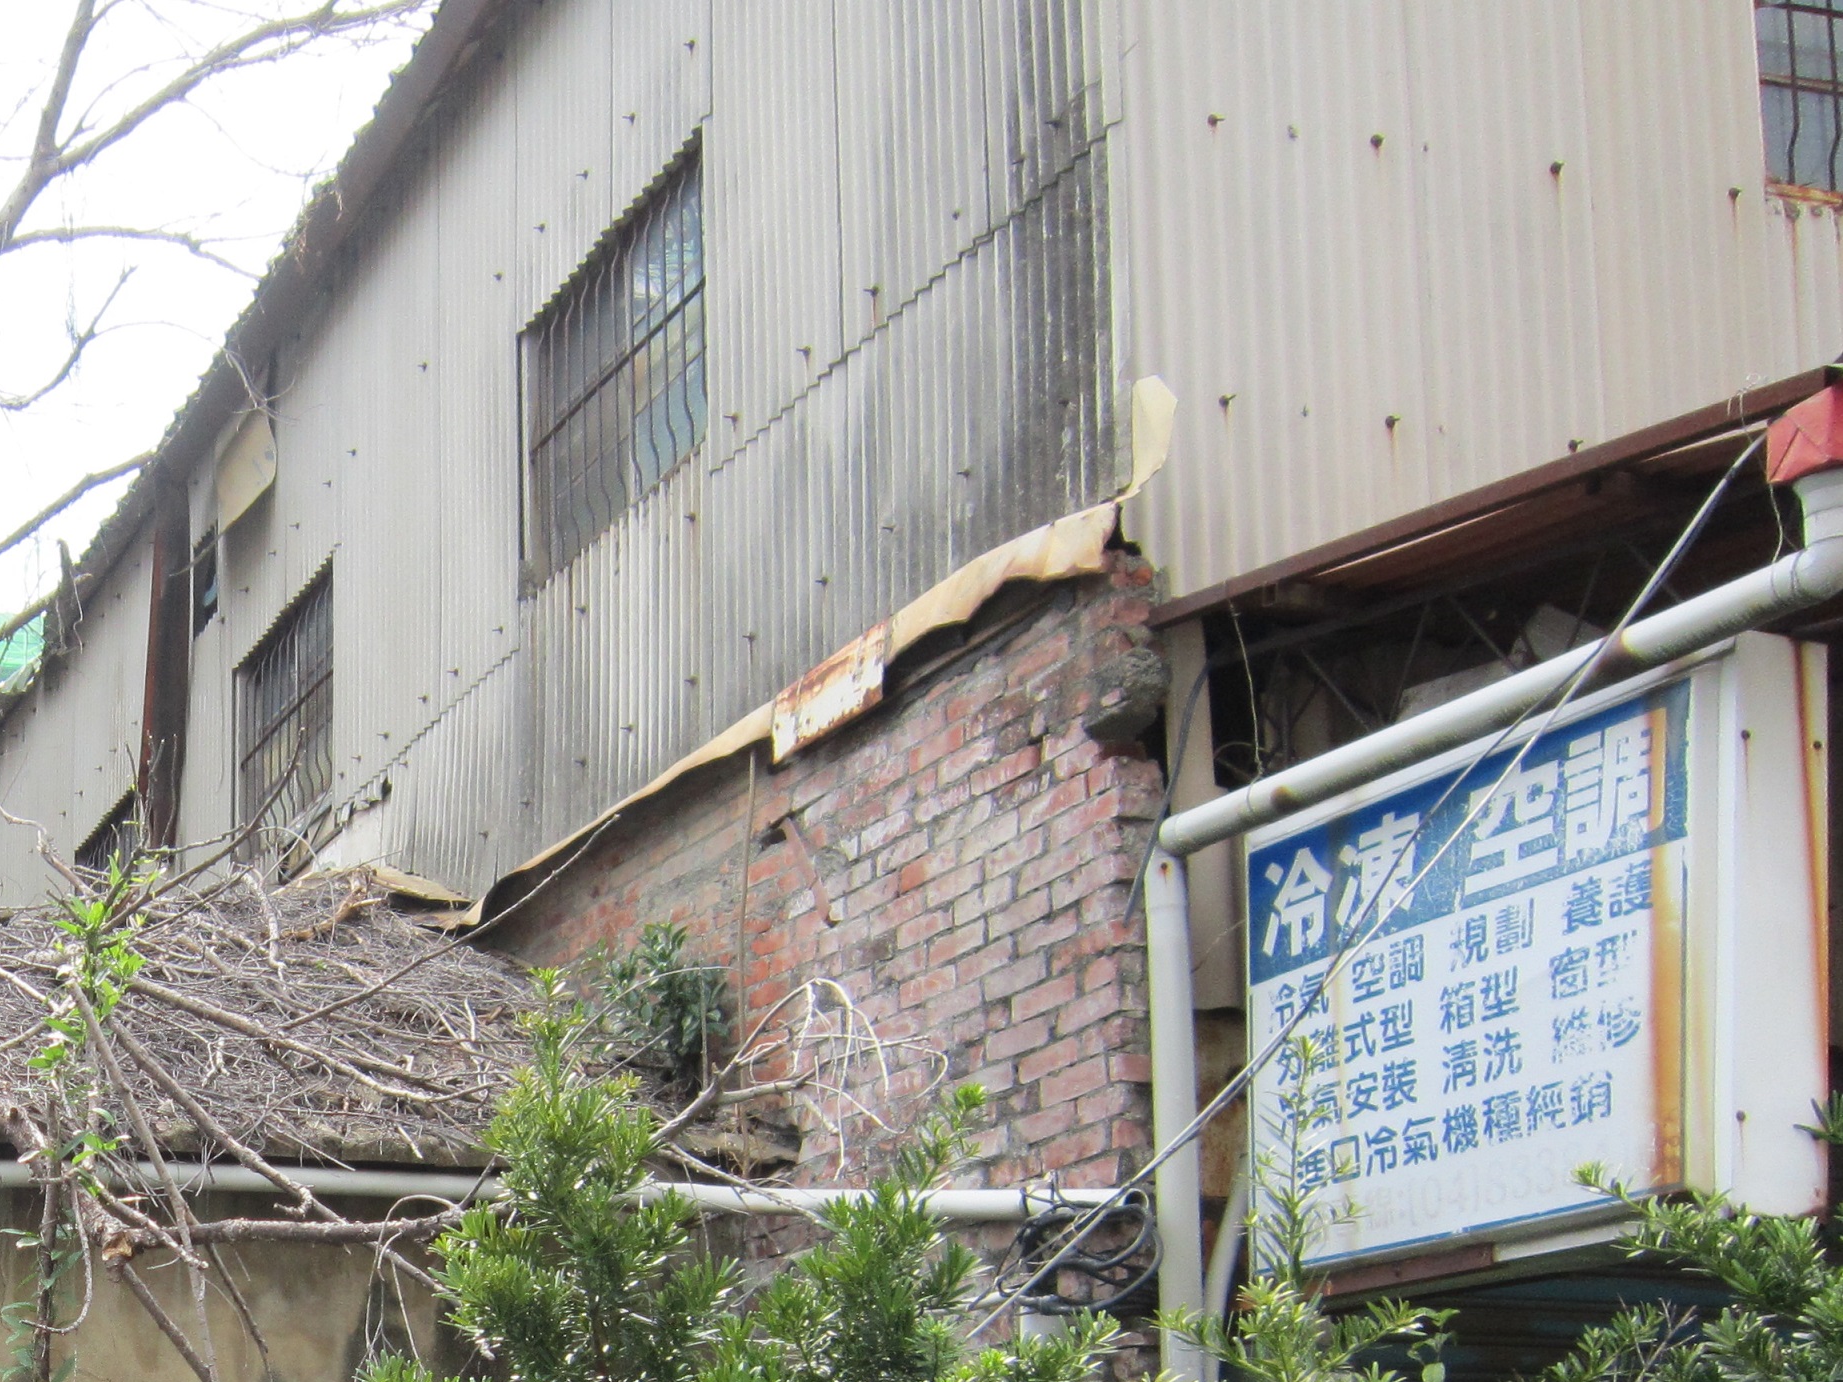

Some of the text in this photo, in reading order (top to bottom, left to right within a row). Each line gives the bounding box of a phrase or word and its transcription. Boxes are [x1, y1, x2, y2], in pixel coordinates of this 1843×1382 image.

[1463, 708, 1667, 898] 空調
[1268, 858, 1654, 1034] 冷氣 空調 規劃 養護
[1439, 965, 1521, 1035] 箱型
[1441, 1027, 1523, 1095] 清洗
